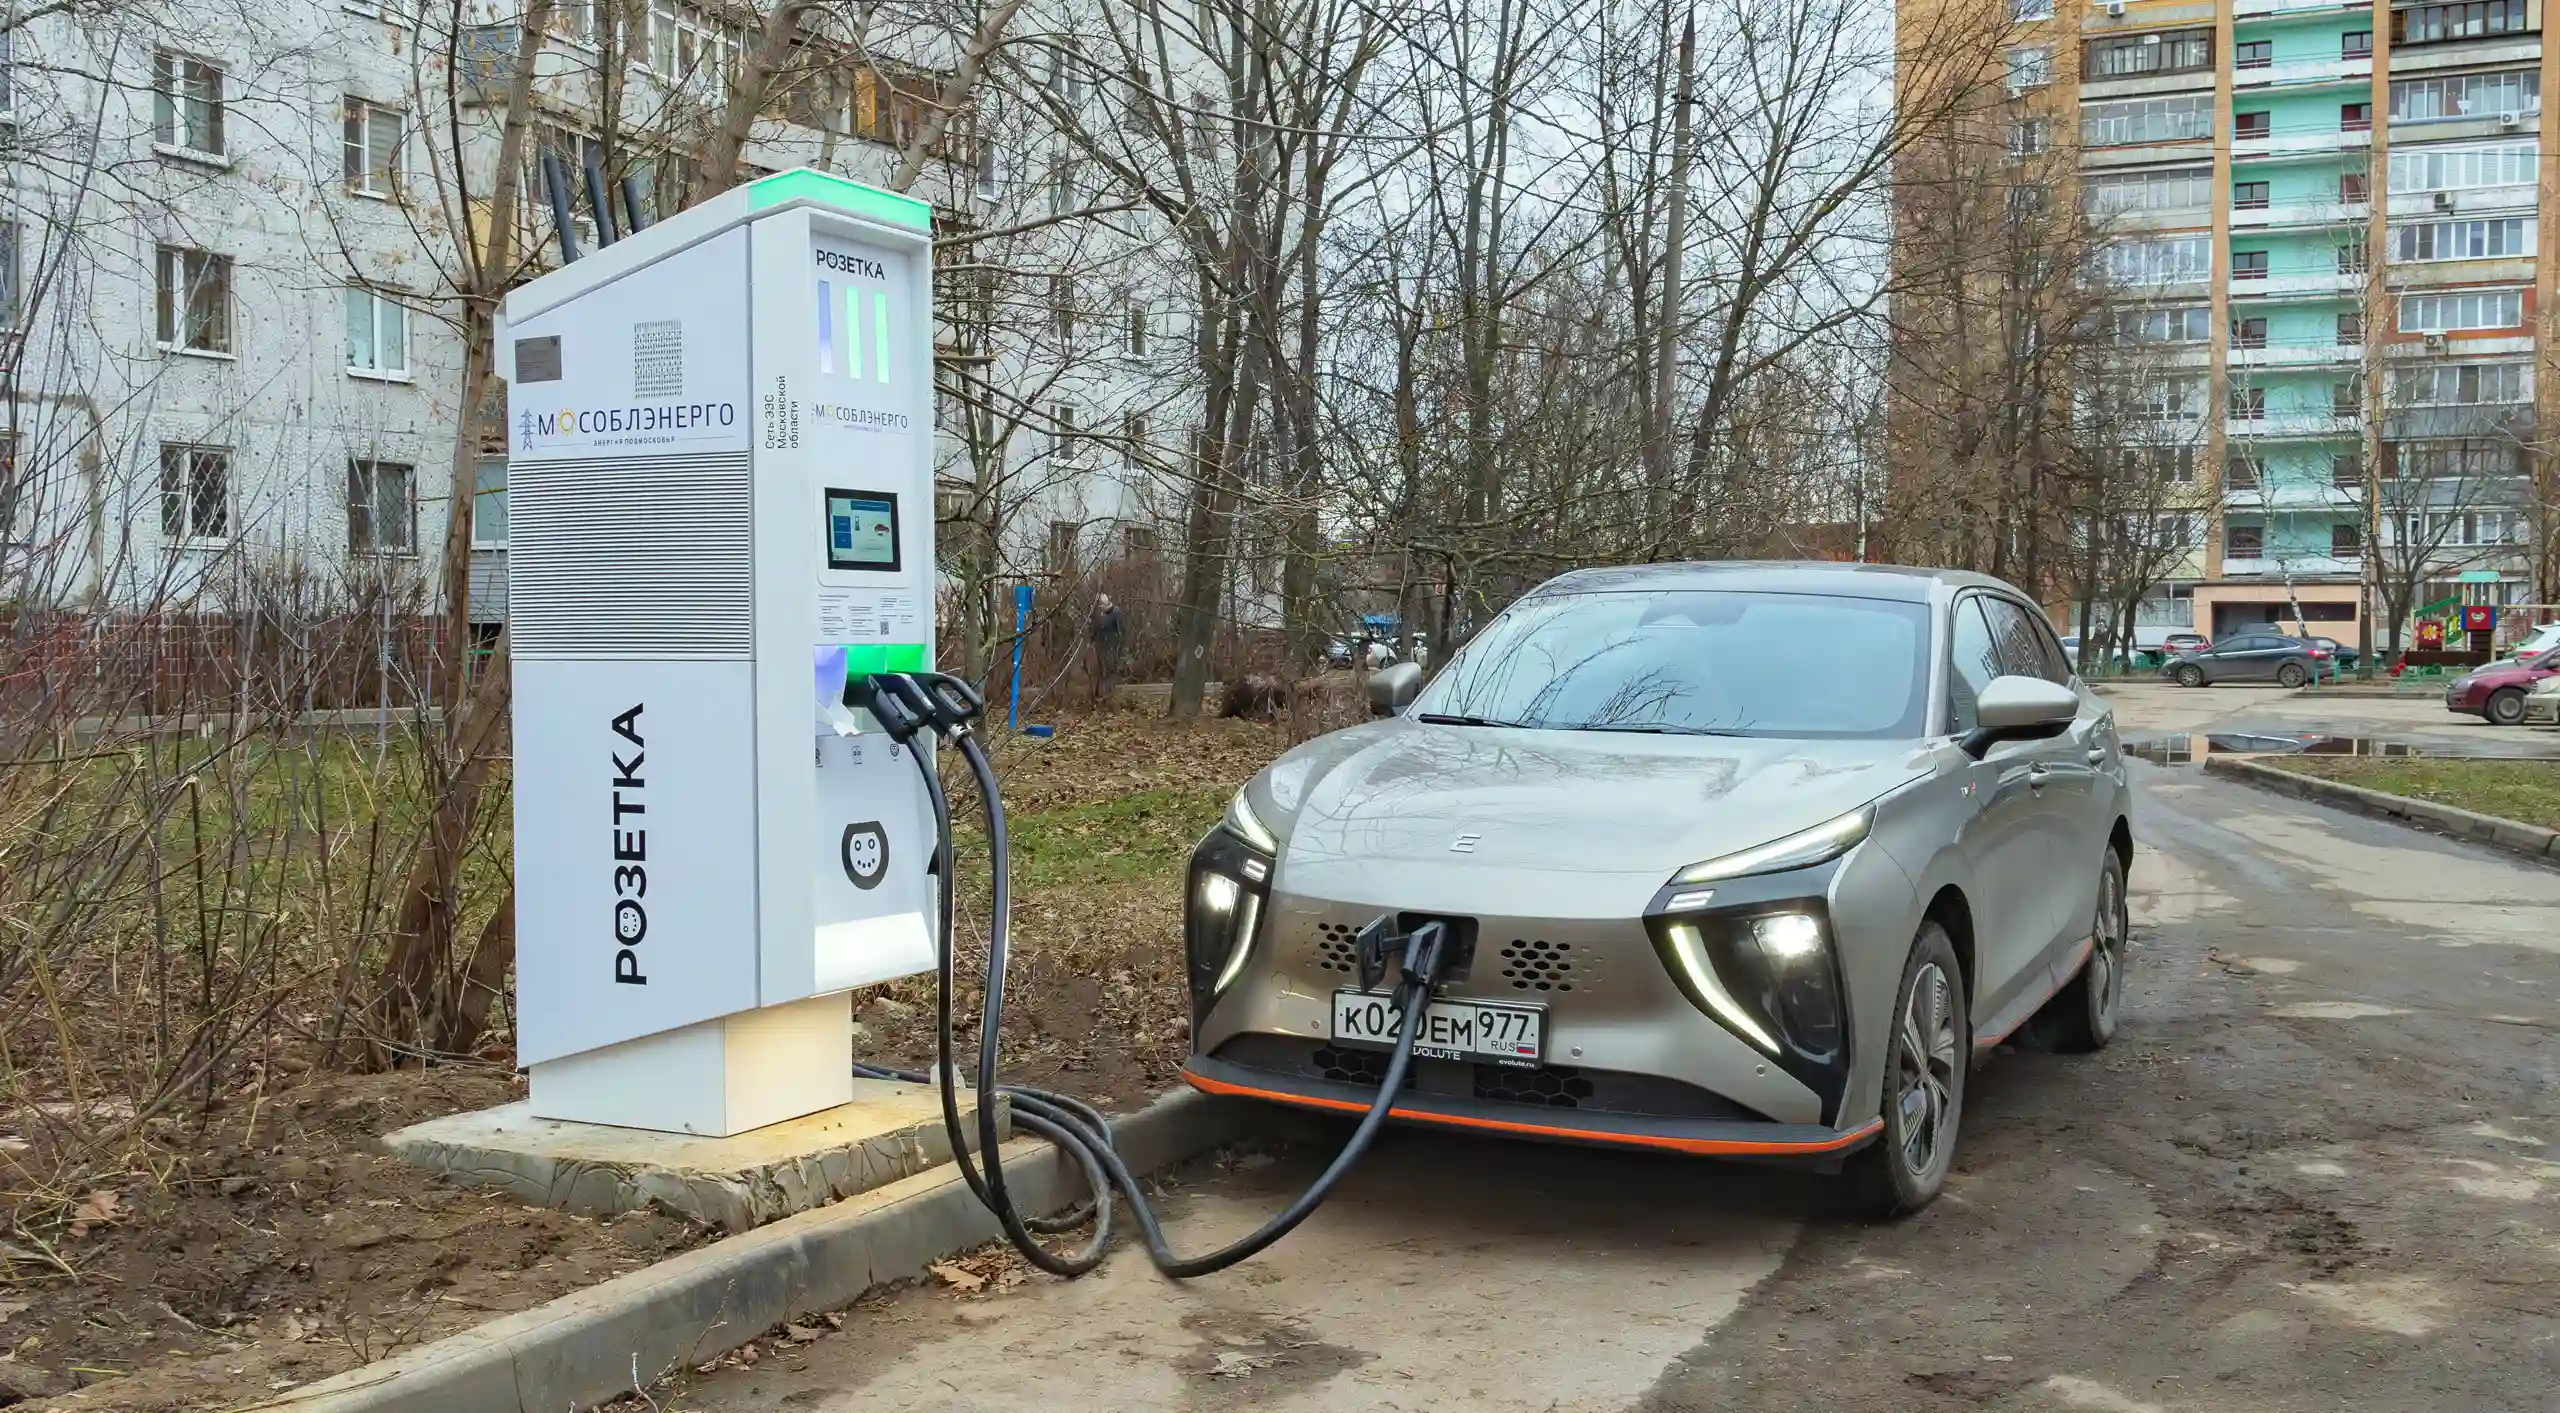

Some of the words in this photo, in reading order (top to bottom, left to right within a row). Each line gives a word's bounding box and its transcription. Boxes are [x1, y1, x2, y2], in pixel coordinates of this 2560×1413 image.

[816, 248, 886, 280] РОЗЕТКА
[538, 402, 734, 436] МОСОБЛЭНЕРГО
[765, 394, 775, 419] ЭЗС
[776, 376, 787, 449] Московской
[816, 404, 908, 429] МОСОБЛЭНЕРГО
[765, 422, 775, 449] Сеть
[789, 401, 799, 449] области
[612, 702, 648, 986] РОЗЕТКА
[1478, 1011, 1529, 1041] 977
[1413, 1046, 1461, 1060] VOLUTE
[1491, 1040, 1516, 1052] RUS
[1498, 1059, 1535, 1069] evolute.ru
